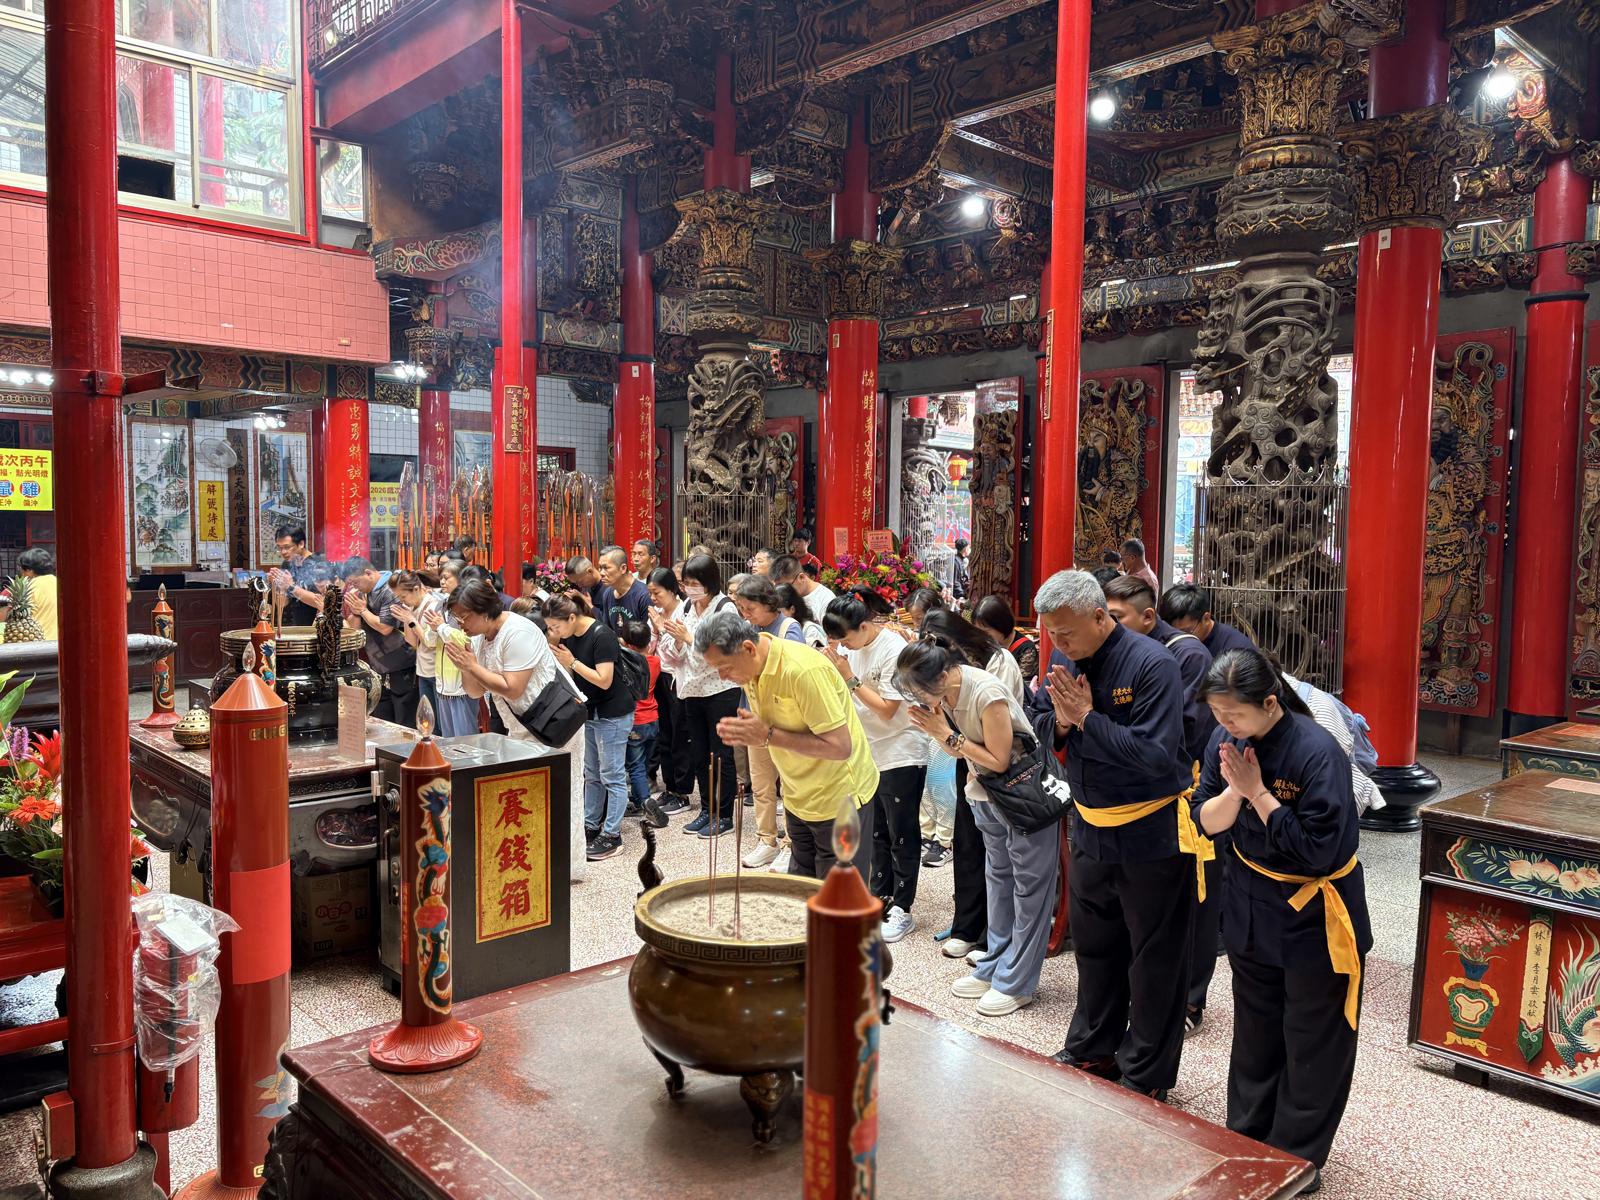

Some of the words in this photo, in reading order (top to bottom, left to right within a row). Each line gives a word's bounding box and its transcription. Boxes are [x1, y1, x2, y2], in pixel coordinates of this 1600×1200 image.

[22, 482, 39, 496] 雞
[494, 787, 533, 921] 賽錢箱
